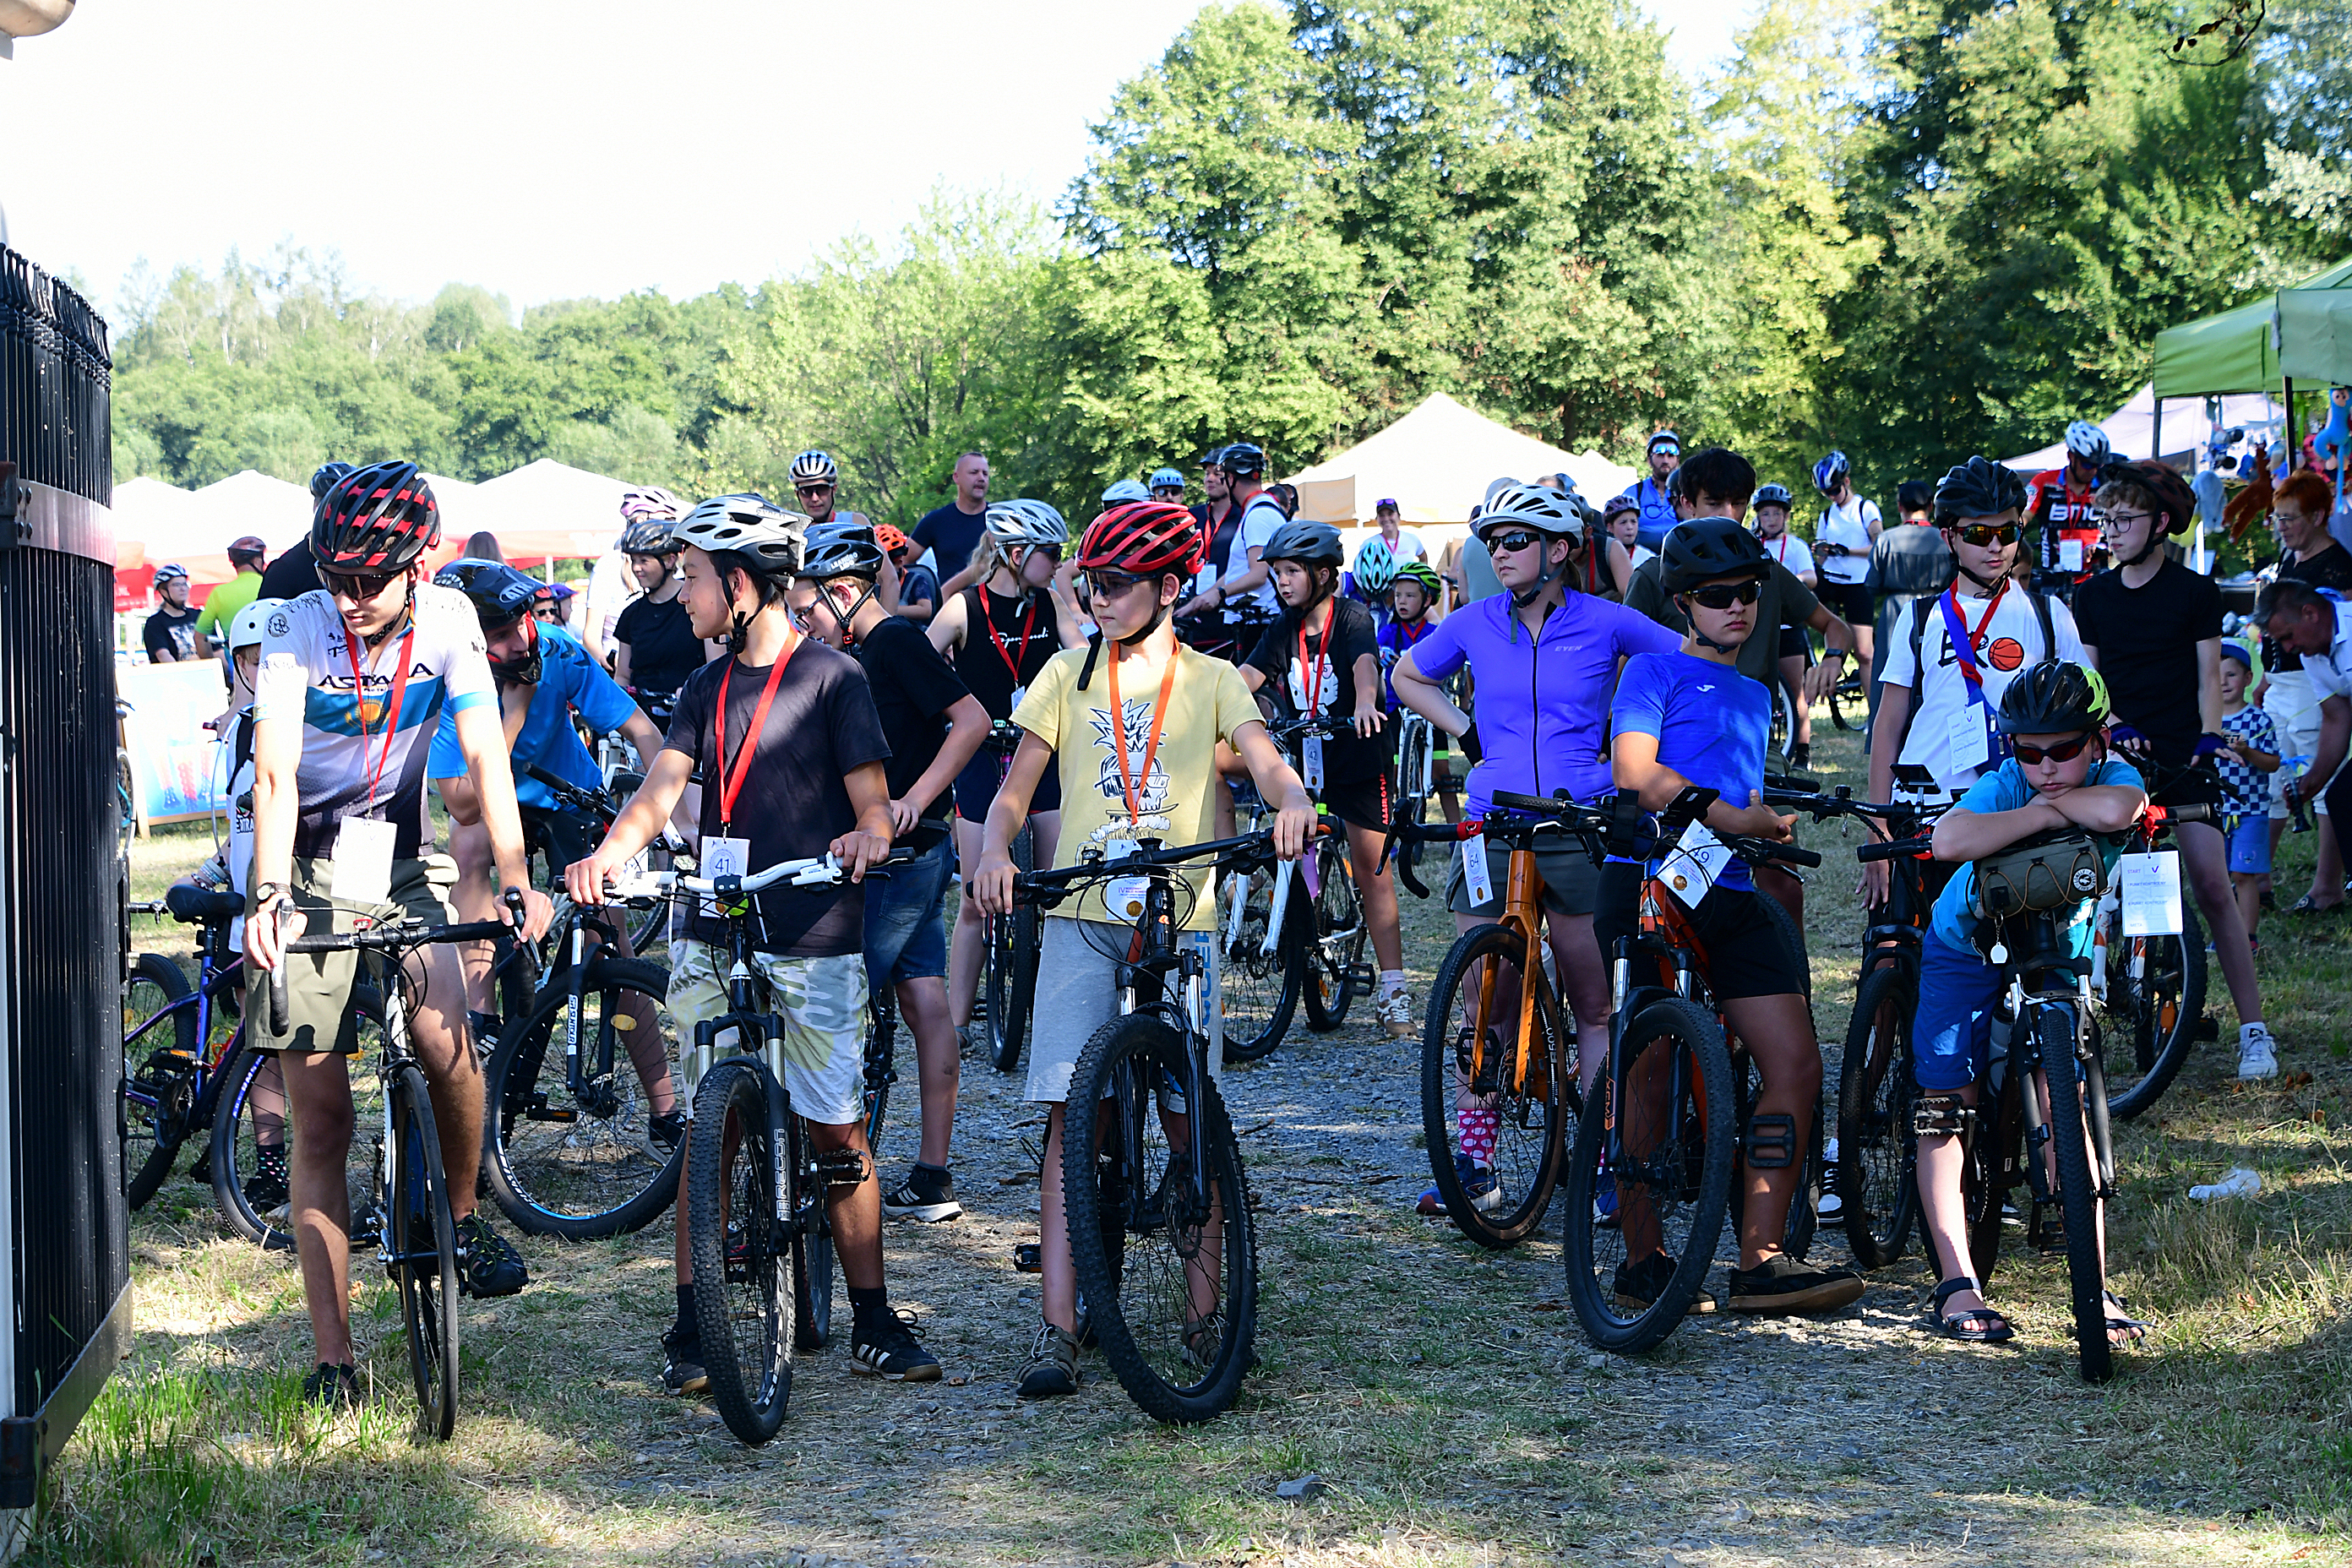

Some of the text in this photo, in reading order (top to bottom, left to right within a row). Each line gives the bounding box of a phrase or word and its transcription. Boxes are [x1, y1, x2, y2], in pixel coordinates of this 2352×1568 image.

[830, 551, 858, 569] LEANDRO
[318, 662, 435, 689] ASTAA
[1309, 750, 1317, 761] 42
[715, 858, 731, 874] 41
[1470, 853, 1479, 868] 64
[774, 1128, 787, 1199] RECON
